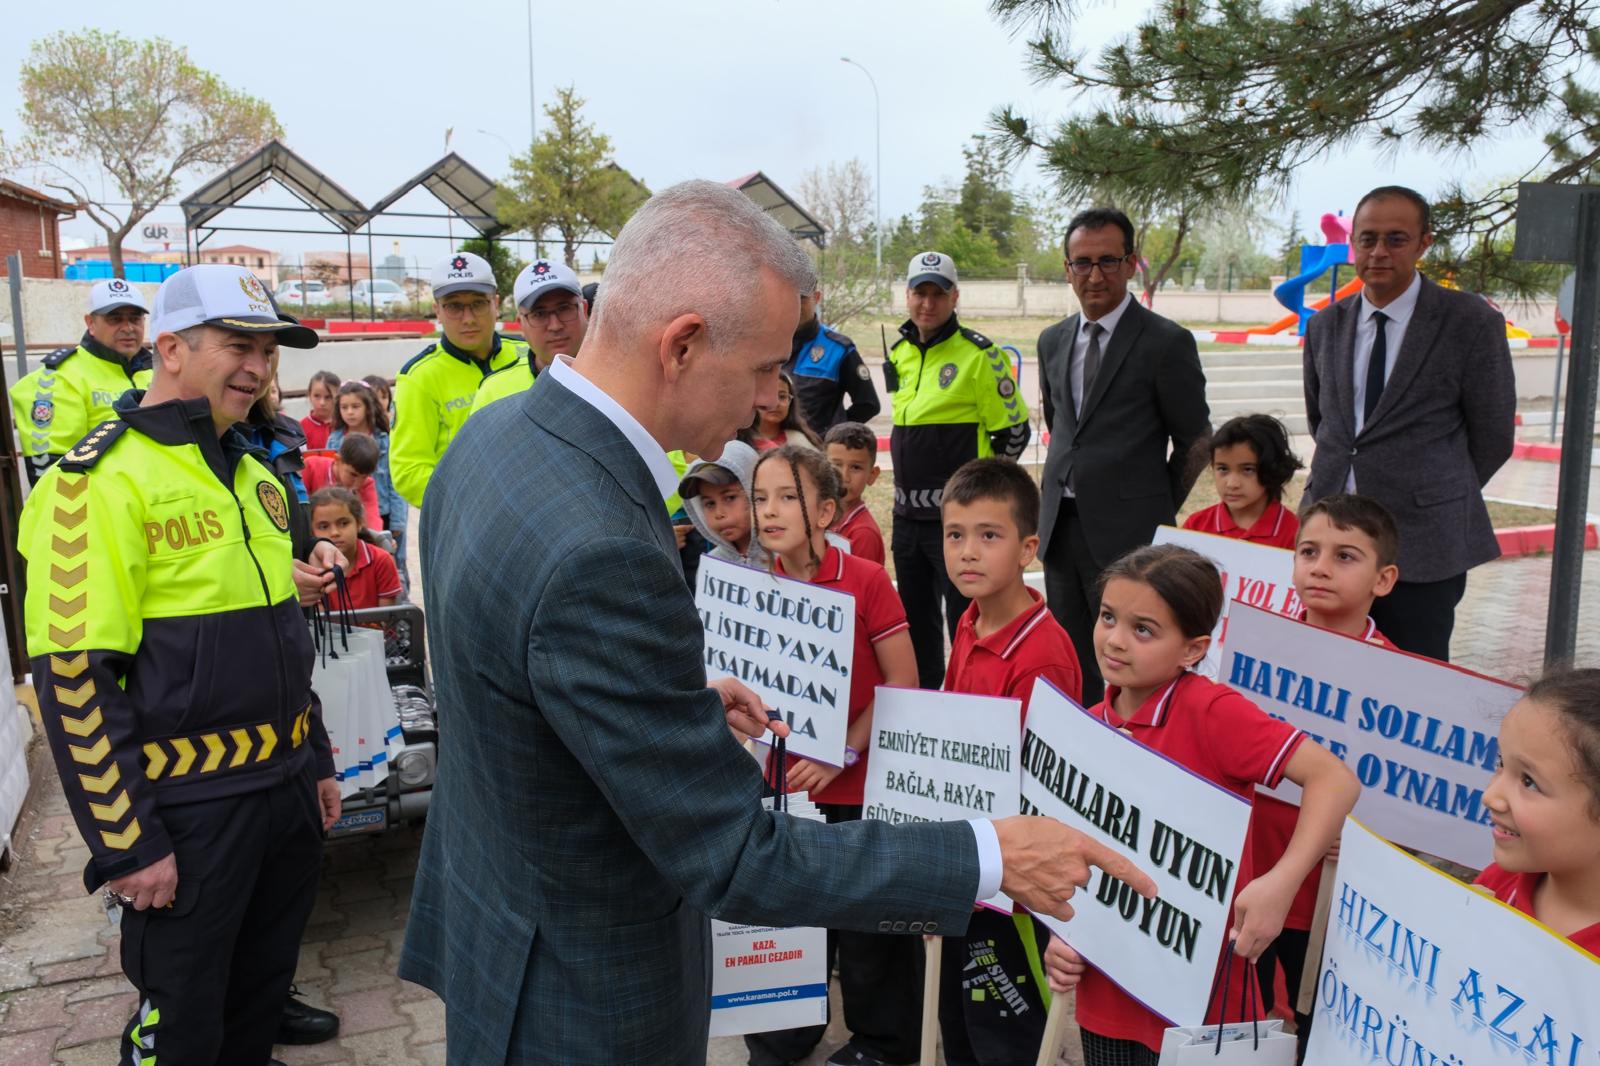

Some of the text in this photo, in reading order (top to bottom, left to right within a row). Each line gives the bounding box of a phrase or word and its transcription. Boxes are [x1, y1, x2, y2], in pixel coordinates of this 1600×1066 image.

[703, 570, 844, 634] İSTER SÜRÜCÜ
[1235, 576, 1276, 612] YOL
[717, 611, 772, 652] İSTER
[777, 633, 848, 677] YAYA,
[705, 646, 837, 708] KSATMADAN
[1228, 651, 1352, 723] HATALI
[1358, 696, 1500, 772] SOLLAM
[878, 730, 1012, 773] EMNİYET KEMERİNİ
[886, 769, 940, 802] BAĞLA,
[943, 781, 995, 814] HAYAT
[1020, 728, 1142, 853] KURALLARA
[1149, 819, 1234, 906] UYUN
[725, 949, 803, 968] EN PAHALI CEZADIR
[752, 940, 777, 951] KAZA:
[1337, 881, 1442, 991] HIZINI
[986, 964, 1030, 1016] SPIRIT
[1322, 957, 1465, 1066] ÖMRÜN
